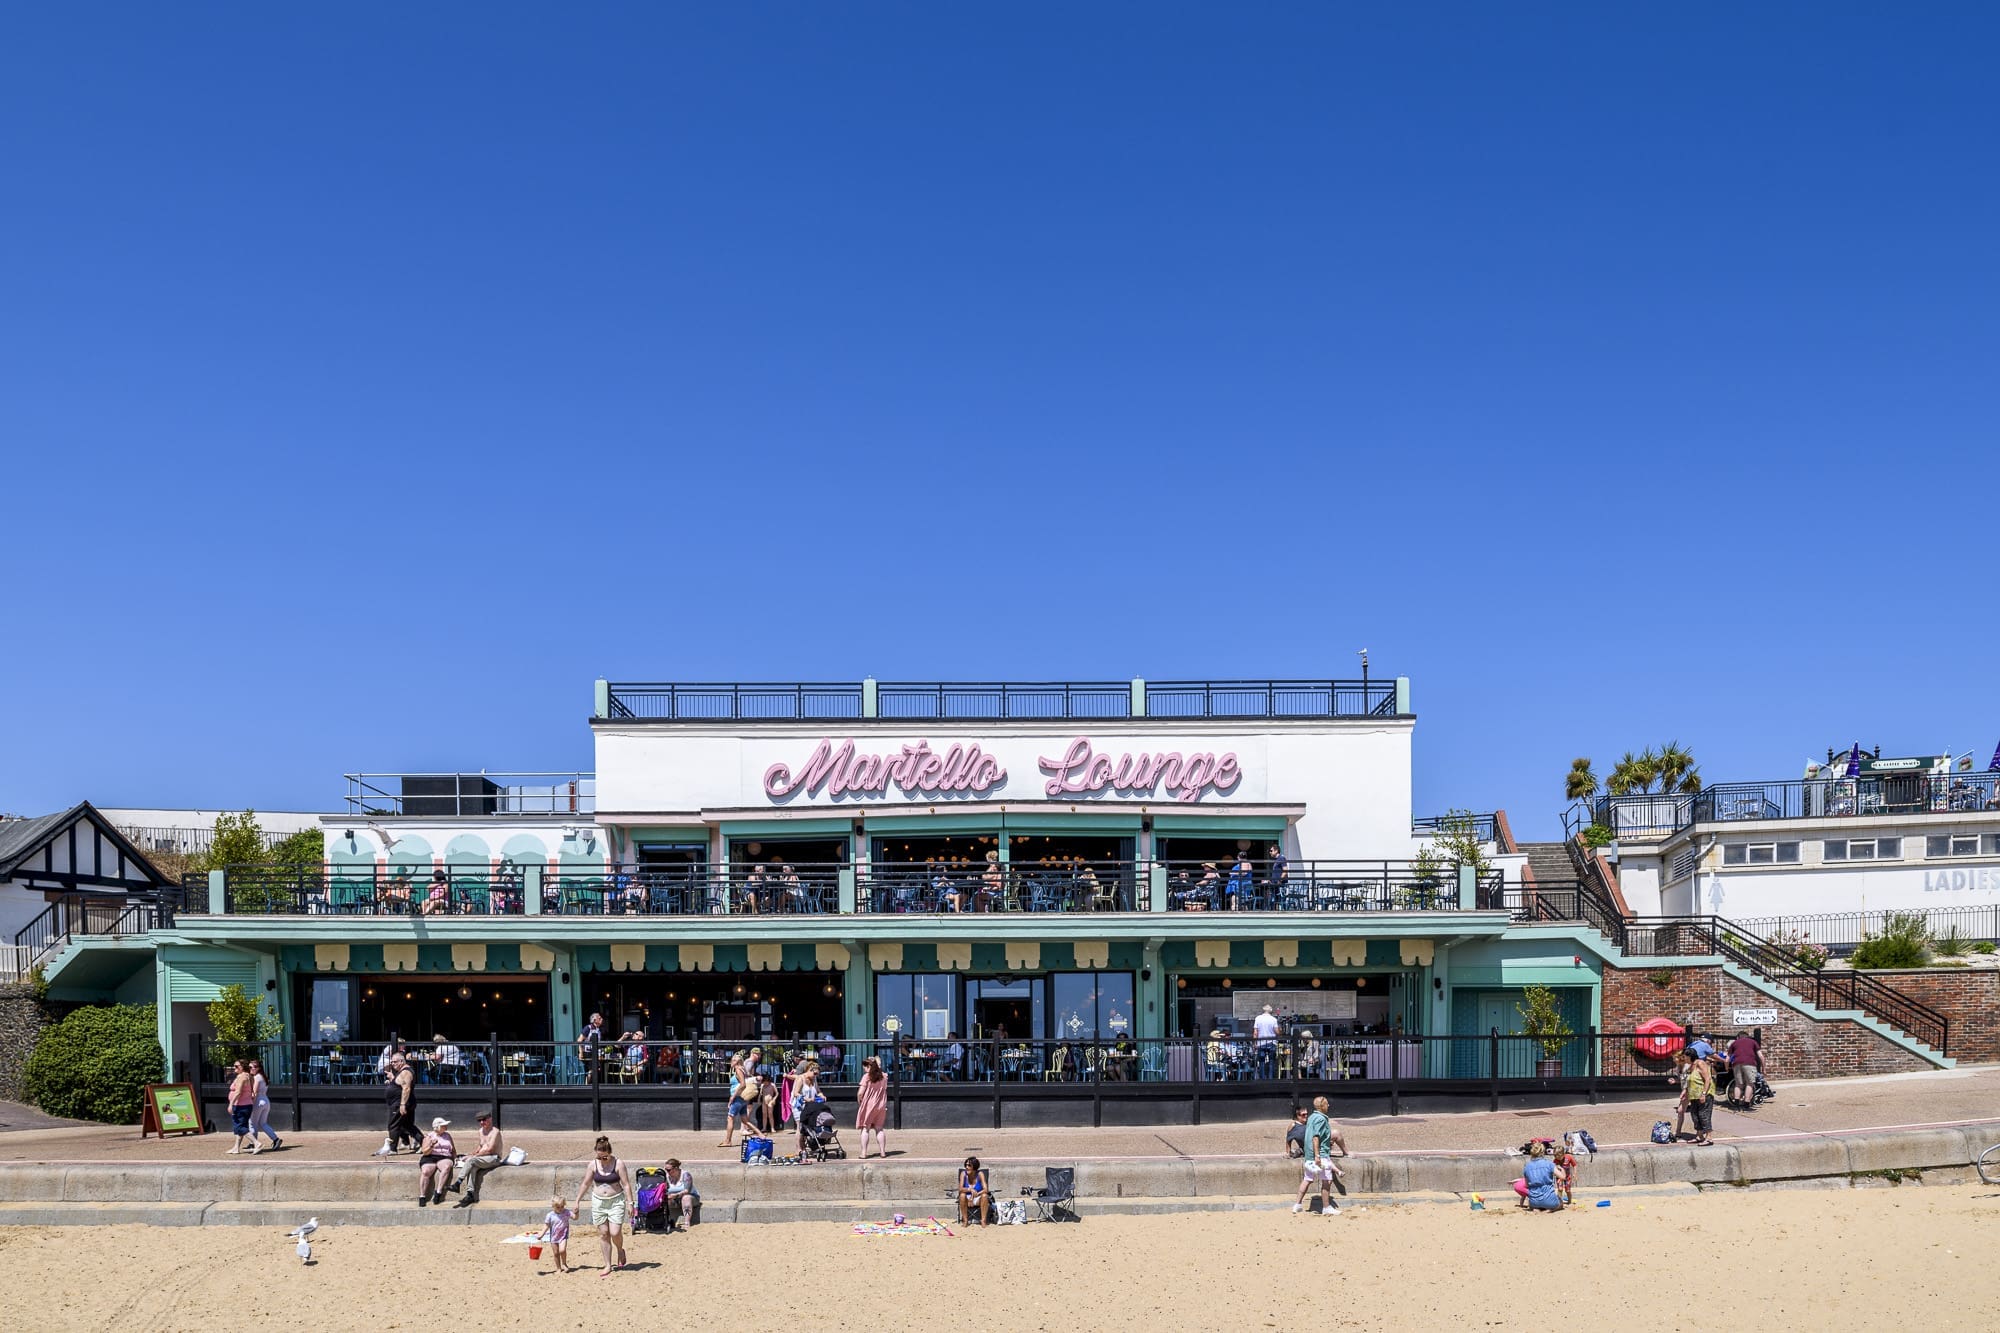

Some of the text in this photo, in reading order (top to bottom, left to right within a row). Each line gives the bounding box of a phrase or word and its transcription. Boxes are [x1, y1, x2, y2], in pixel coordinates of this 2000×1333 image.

[764, 737, 1241, 802] Martello Lounge
[1924, 869, 2000, 891] LADIES
